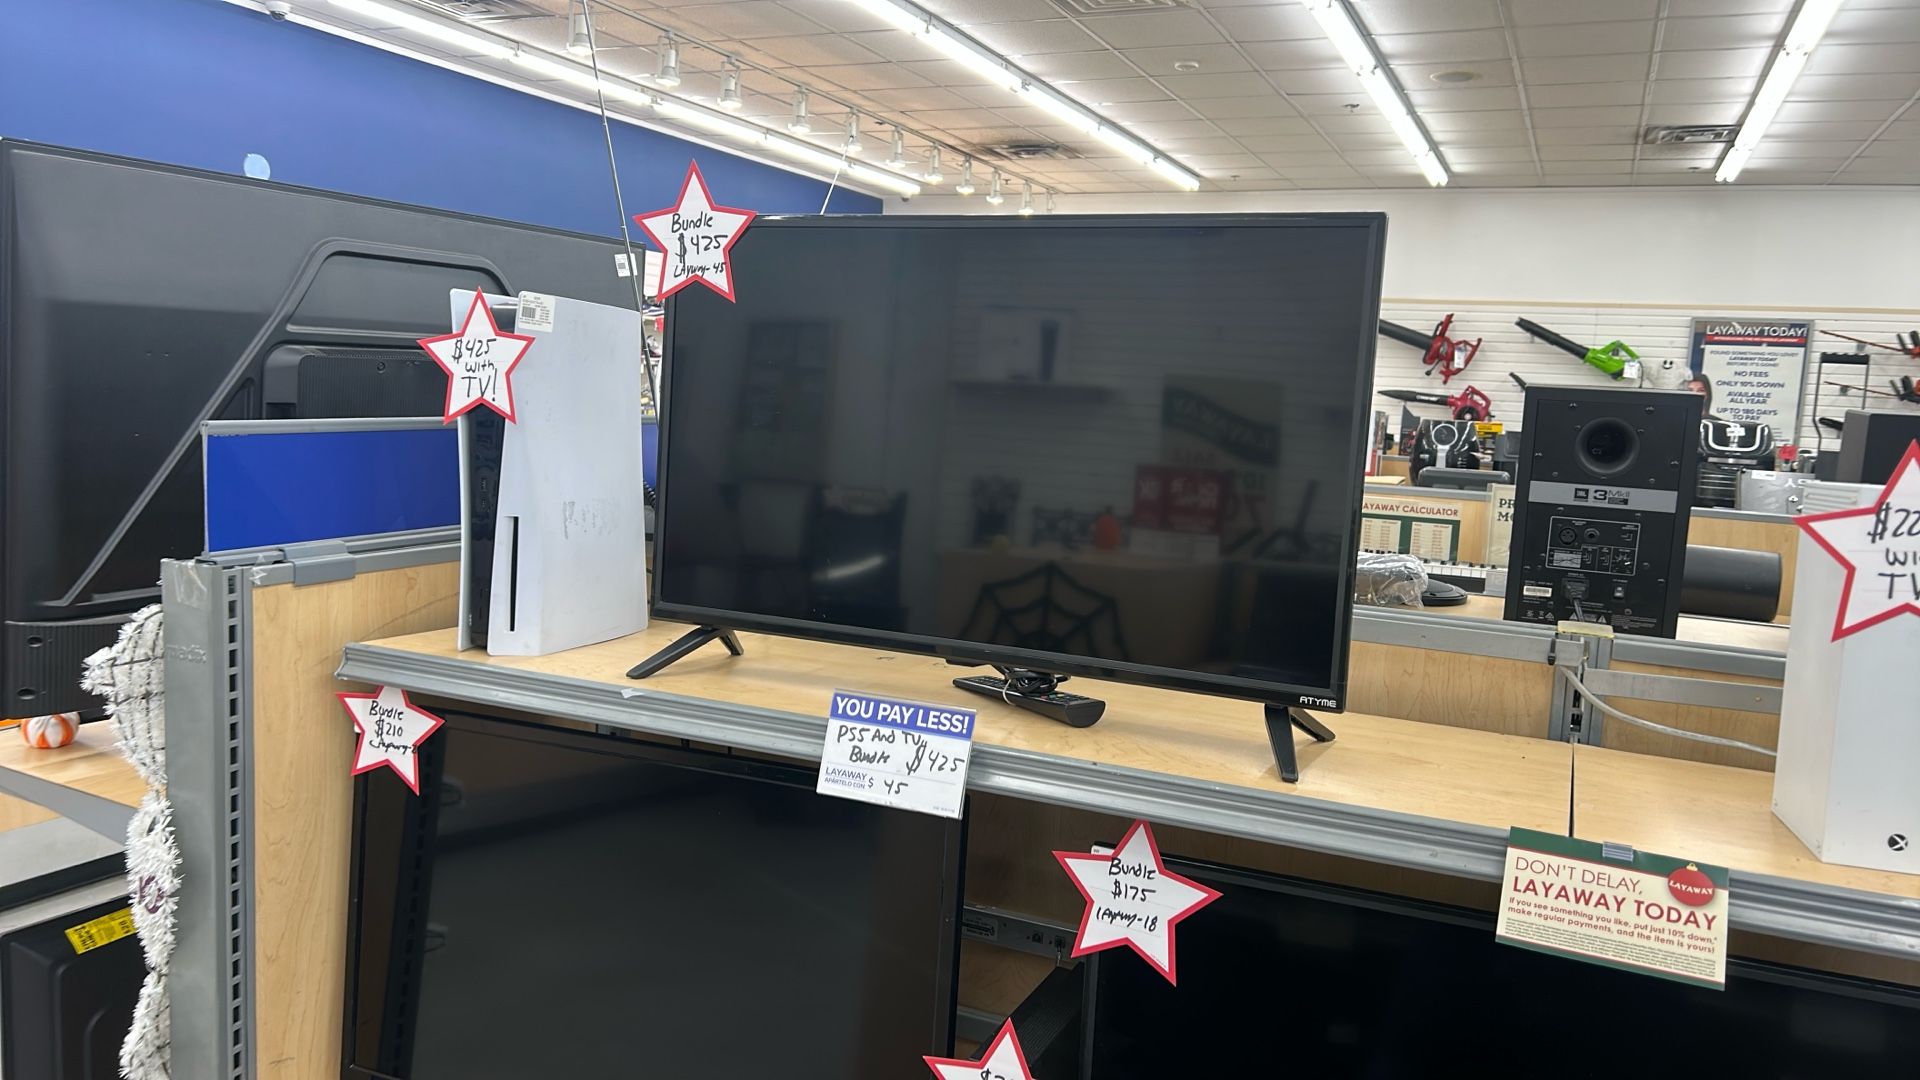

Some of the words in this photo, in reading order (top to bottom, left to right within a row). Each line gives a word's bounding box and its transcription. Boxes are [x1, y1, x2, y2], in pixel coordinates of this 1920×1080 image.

[671, 211, 713, 233] Bundle
[675, 233, 728, 266] $425
[1706, 325, 1762, 336] LAYAWAY
[1763, 326, 1808, 337] TODAY!
[452, 338, 497, 364] $425
[461, 368, 497, 402] TV!
[1727, 391, 1772, 399] AVAILABLE
[1594, 490, 1608, 500] 3
[1402, 504, 1459, 517] CALCULATOR
[369, 700, 404, 721] Bundle
[1300, 696, 1336, 708] ATYME
[836, 696, 875, 719] YOU
[877, 703, 914, 725] PAY
[917, 709, 970, 734] LESS!
[375, 717, 404, 738] $210
[837, 724, 870, 743] PS5
[901, 731, 921, 746] TV
[849, 745, 890, 764] Bundle
[906, 739, 965, 775] $425
[825, 766, 867, 781] LAYAWAY
[868, 777, 874, 788] $
[884, 779, 908, 796] 45
[1108, 857, 1156, 880] Bundle
[1516, 856, 1576, 880] DON'T
[1582, 869, 1642, 895] DELAY,
[1111, 879, 1156, 902] $175
[1668, 880, 1714, 895] LAYAWAY
[1513, 876, 1626, 912] LAYAWAY
[1634, 899, 1717, 930] TODAY
[1516, 898, 1532, 907] you
[1550, 906, 1594, 921] something
[1596, 915, 1612, 924] you
[1634, 922, 1648, 932] put
[1650, 924, 1665, 934] just
[1668, 928, 1685, 938] 10%
[1508, 906, 1532, 916] make
[1534, 912, 1566, 922] regular
[1568, 919, 1614, 934] payments,
[1616, 928, 1634, 938] and
[1637, 932, 1652, 941] the
[1654, 936, 1674, 946] item
[1677, 939, 1684, 948] is
[1687, 942, 1715, 954] yours!
